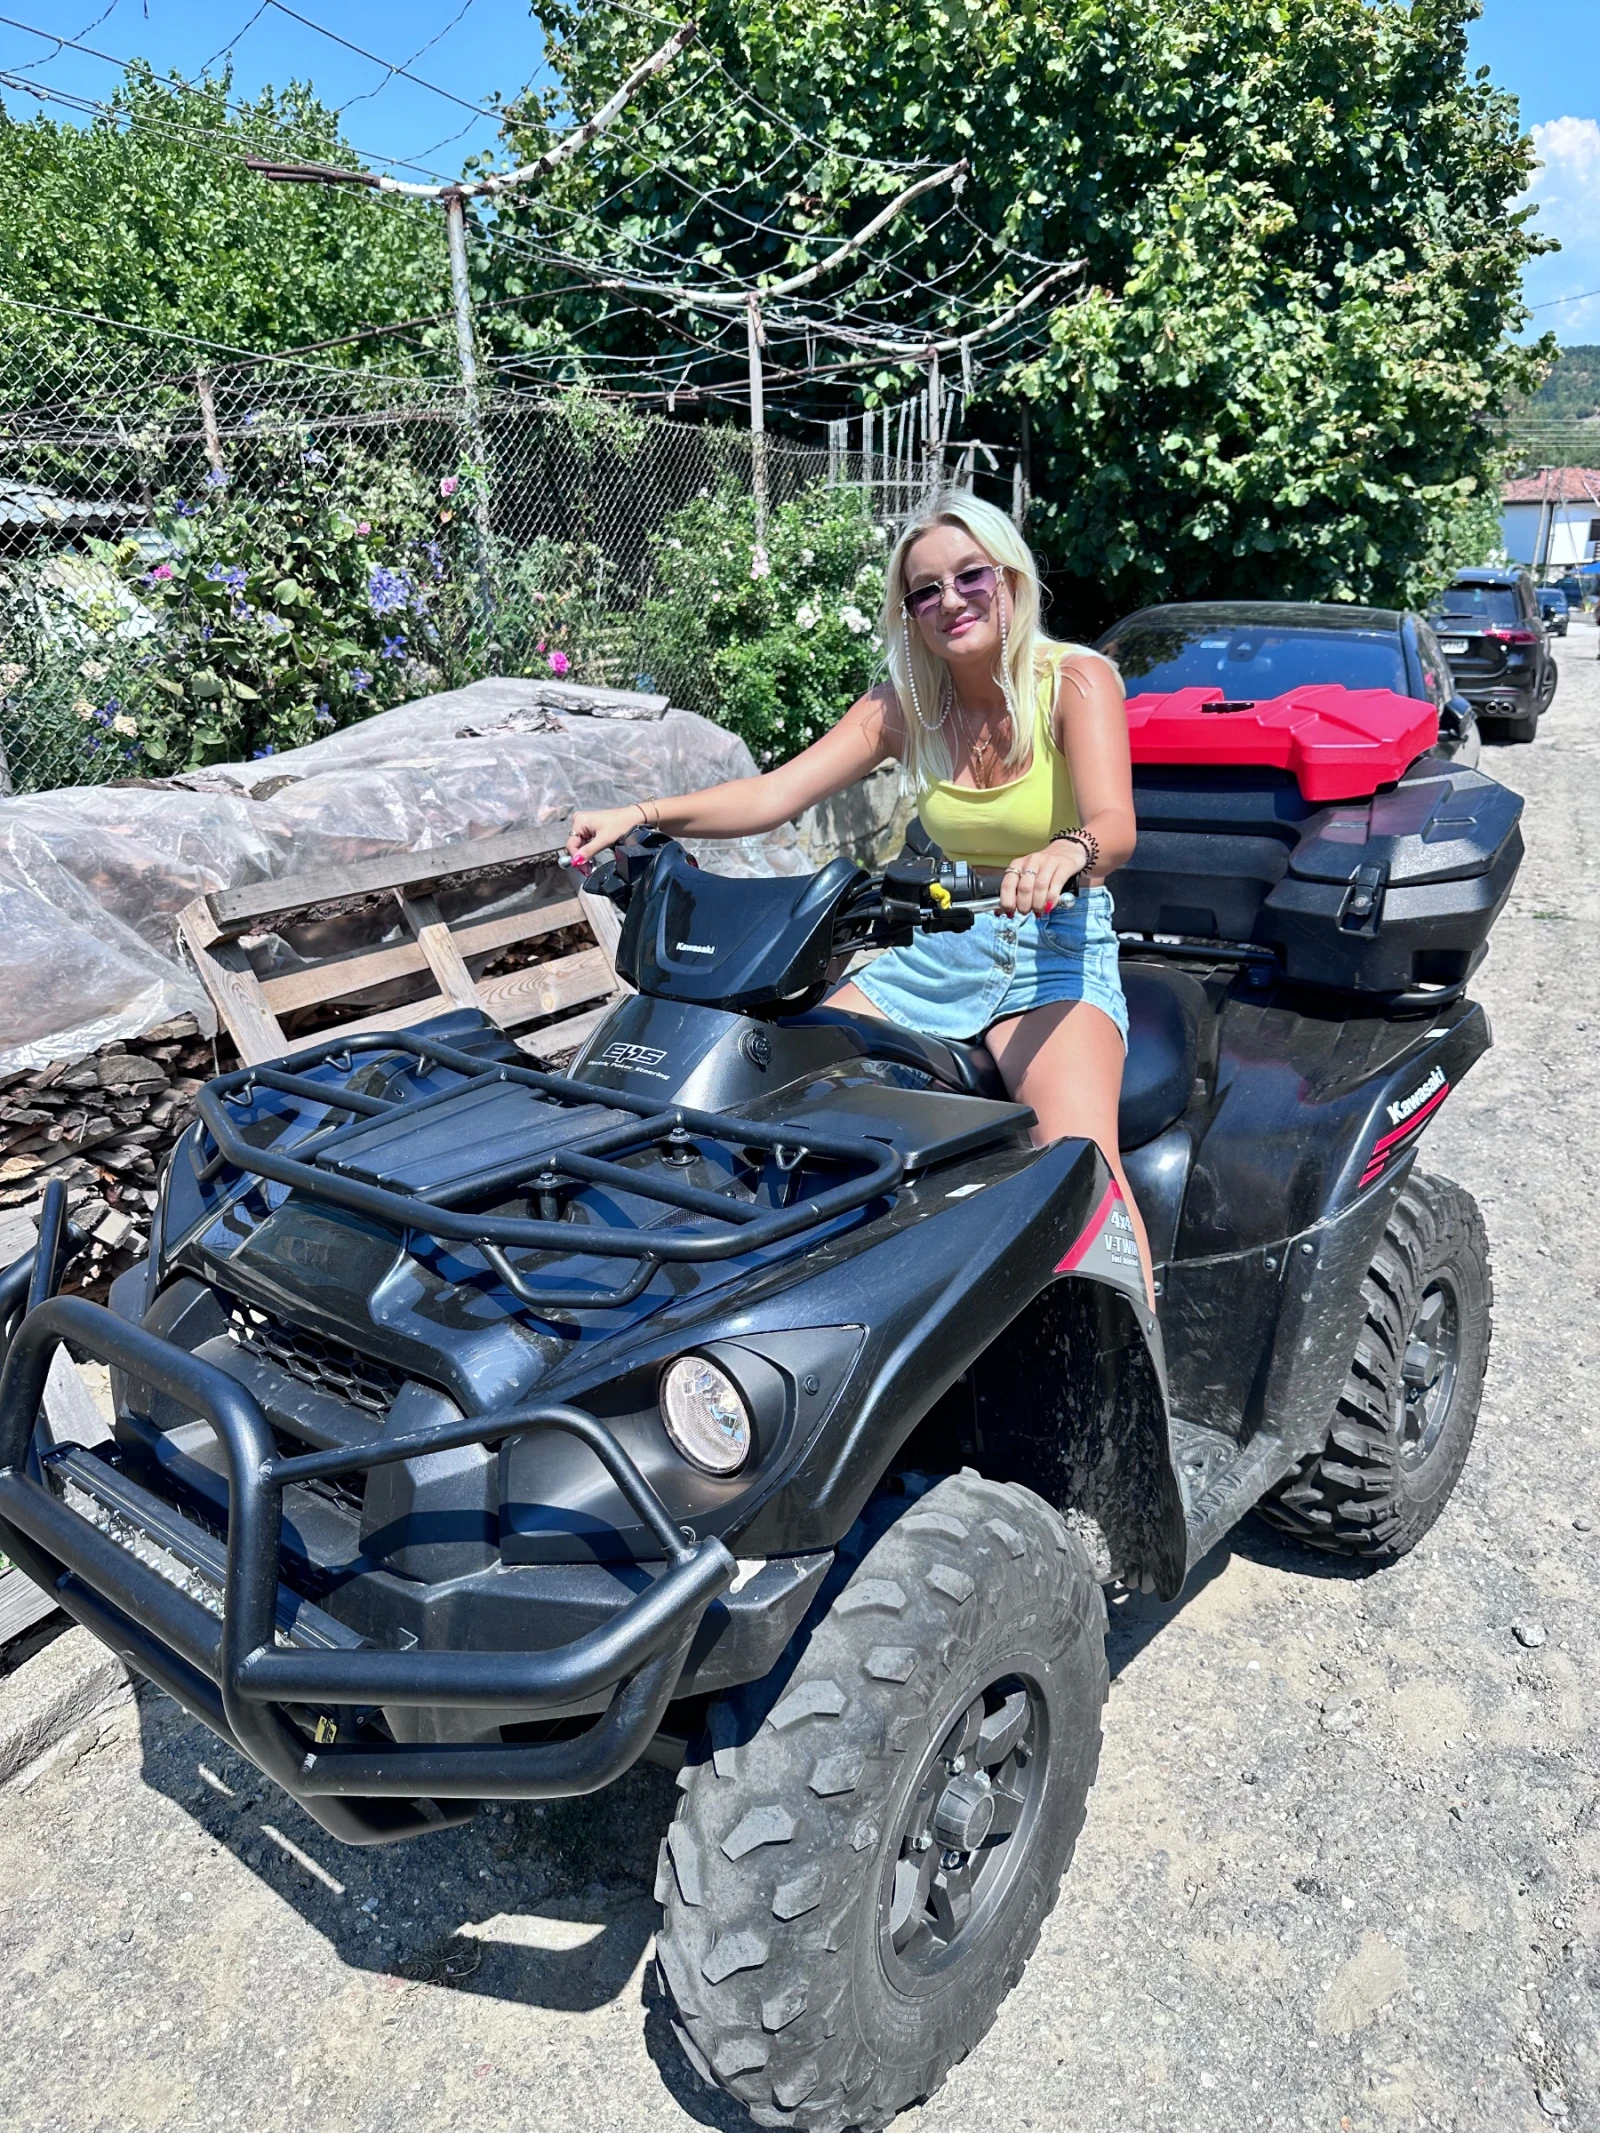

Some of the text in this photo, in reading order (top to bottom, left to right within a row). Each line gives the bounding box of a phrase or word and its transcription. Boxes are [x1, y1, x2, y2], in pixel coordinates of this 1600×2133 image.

[676, 942, 715, 954] Kawasaki
[602, 1042, 668, 1065] EPS
[634, 1066, 671, 1081] Steering
[1386, 1065, 1446, 1125] Kawasaki
